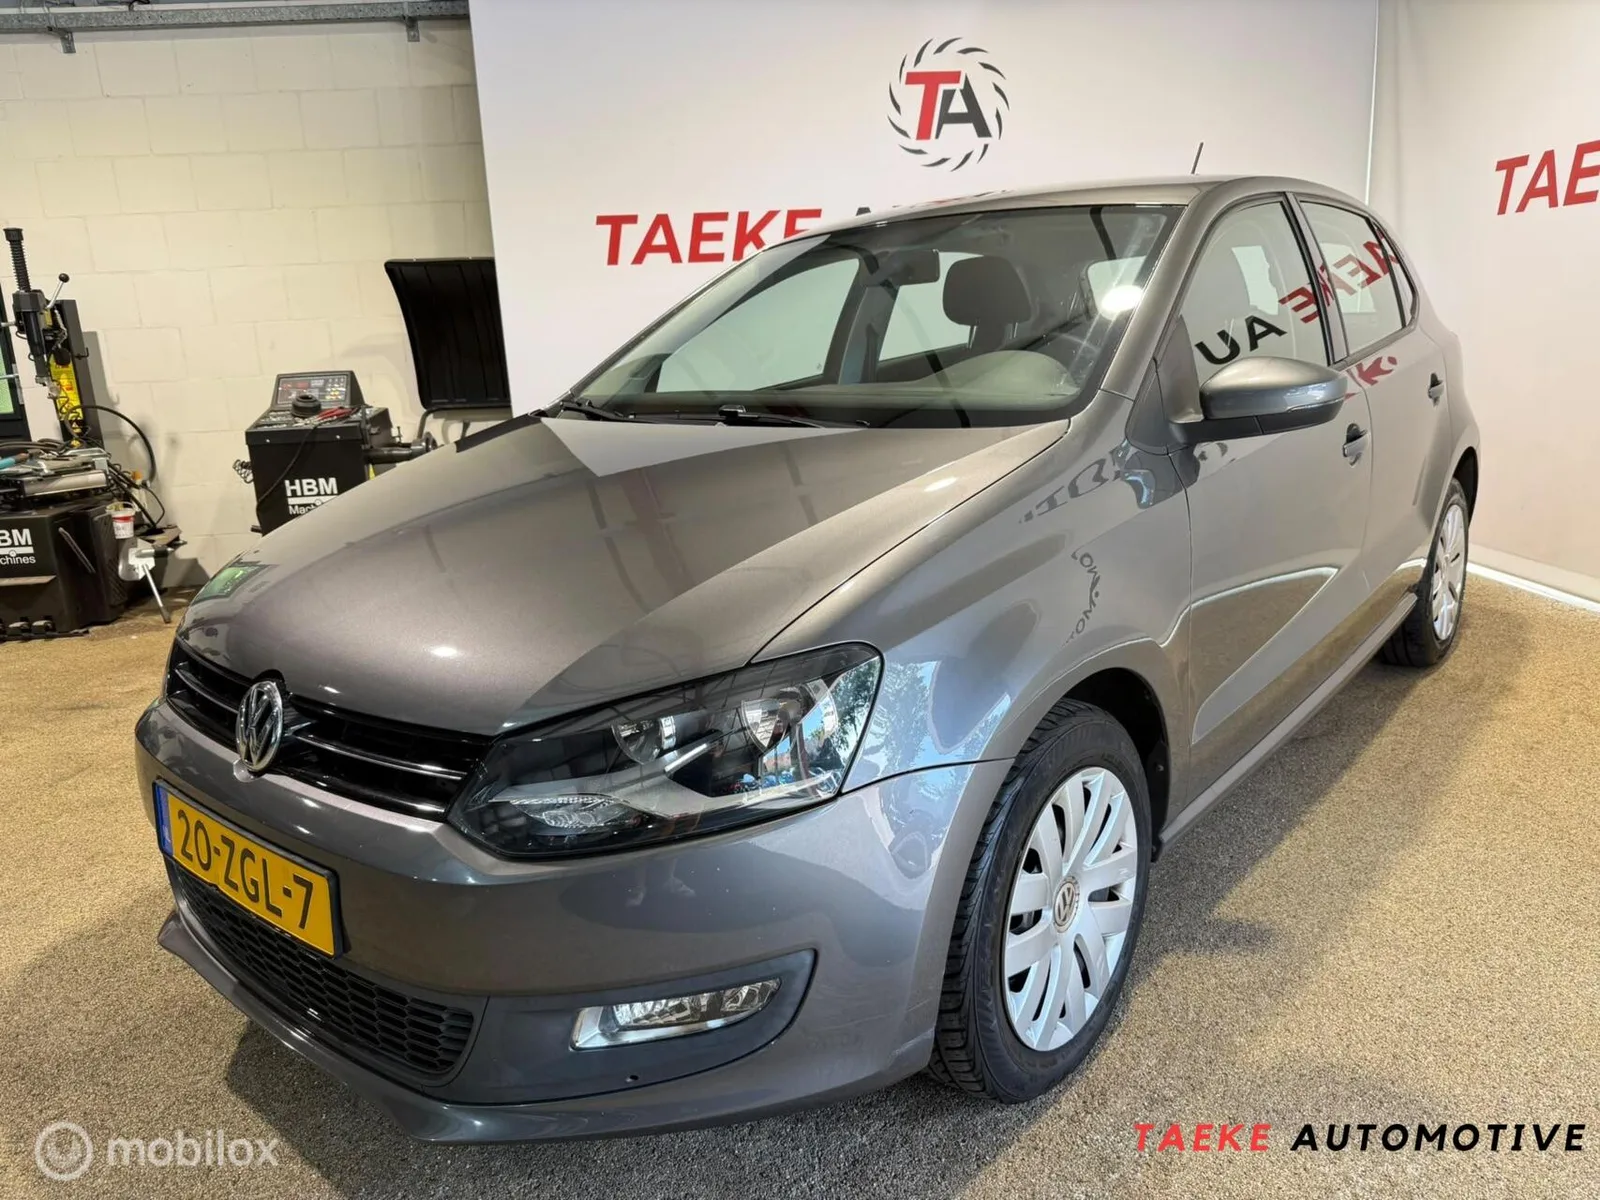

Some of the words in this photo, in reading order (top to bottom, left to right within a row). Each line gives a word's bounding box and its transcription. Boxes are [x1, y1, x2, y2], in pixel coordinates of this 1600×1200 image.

[904, 70, 993, 141] TA
[284, 477, 338, 497] HBM
[0, 528, 33, 547] BM
[177, 808, 314, 930] 20-ZGL-7
